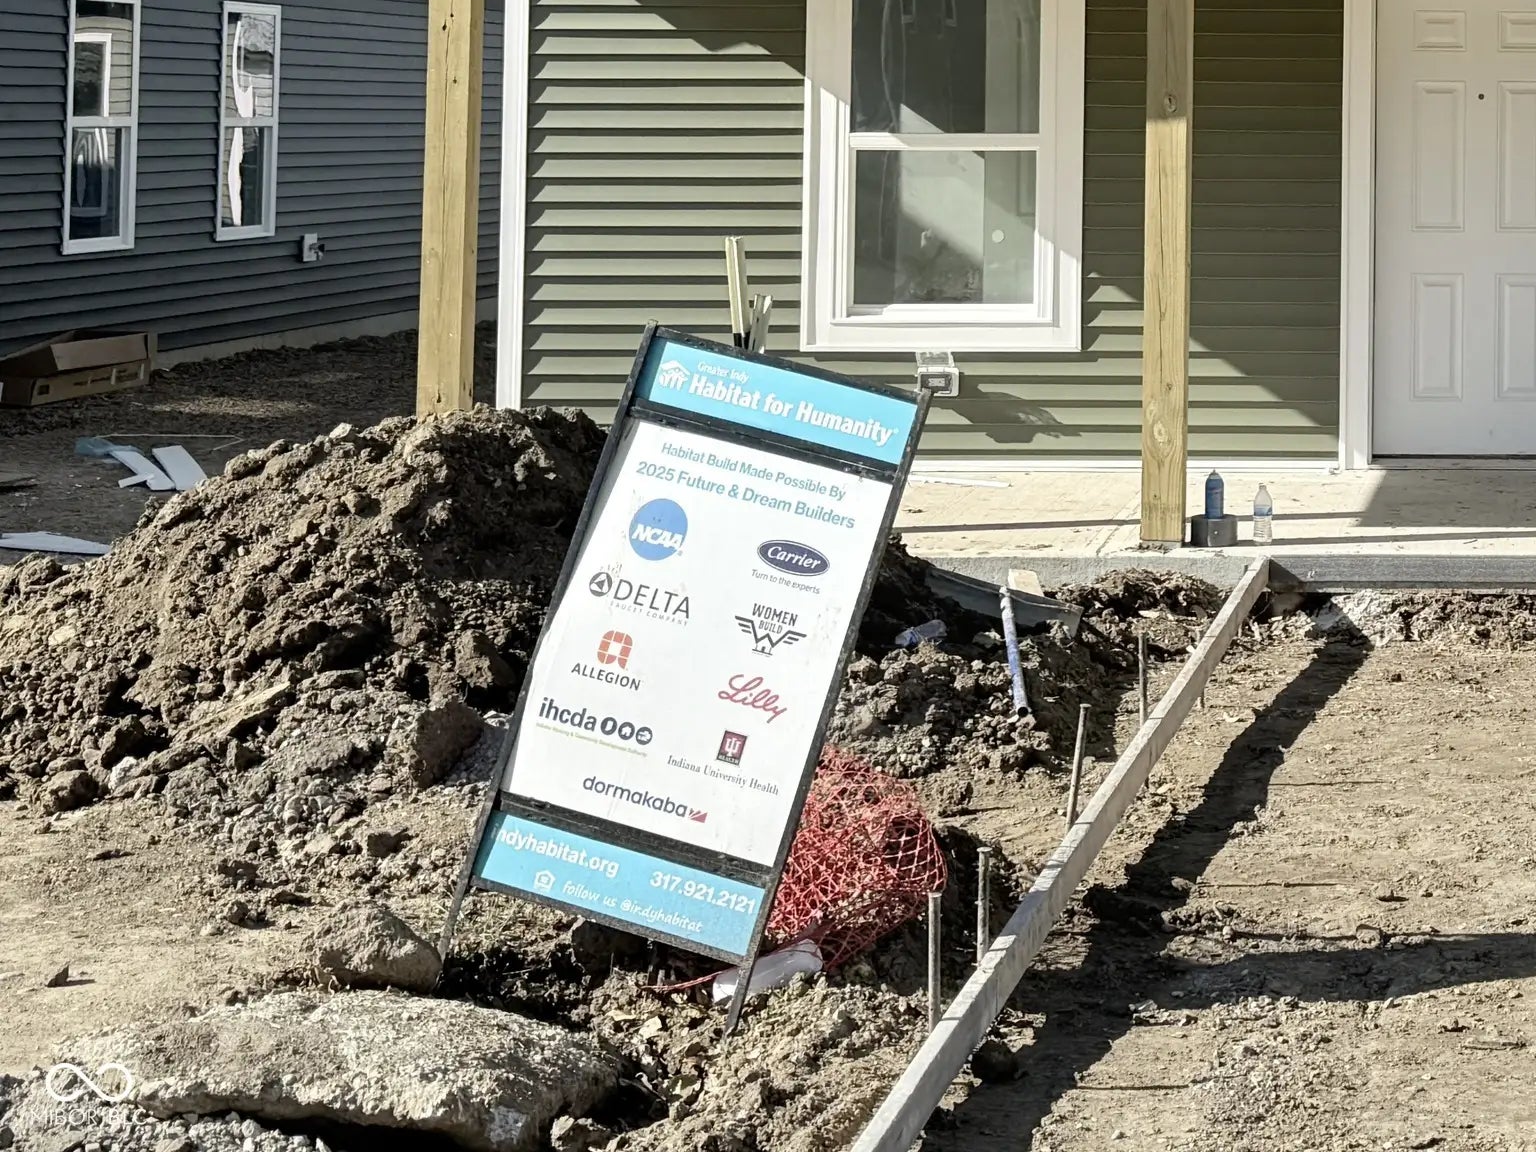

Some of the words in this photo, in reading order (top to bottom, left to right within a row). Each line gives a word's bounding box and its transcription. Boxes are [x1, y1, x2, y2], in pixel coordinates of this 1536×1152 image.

[697, 361, 729, 380] Greater
[730, 369, 750, 385] Indy
[688, 374, 760, 414] Habitat
[762, 392, 793, 418] for
[795, 401, 894, 448] Humanity
[661, 442, 706, 464] Habitat
[705, 454, 738, 473] Build
[738, 461, 773, 482] Made
[775, 471, 827, 495] Possible
[828, 484, 847, 502] By
[636, 460, 675, 483] 2025
[676, 470, 726, 496] Future
[727, 484, 745, 499] &
[742, 486, 792, 515] Dream
[794, 499, 856, 530] Builders
[631, 523, 684, 550] NCAA
[767, 546, 821, 569] Carrier
[751, 569, 768, 581] Turn
[769, 574, 778, 583] to
[778, 576, 791, 587] the
[791, 581, 820, 595] experts
[609, 600, 643, 617] FAUCET
[646, 611, 688, 627] COMPANY
[613, 579, 690, 619] DELTA
[752, 603, 798, 627] WOMEN
[758, 619, 783, 634] BUILD
[571, 662, 641, 691] ALLEGION
[538, 696, 597, 732] ihcda
[718, 674, 787, 724] Lilly
[667, 754, 701, 773] Indiana
[703, 764, 747, 789] University
[749, 777, 779, 796] Health
[582, 775, 687, 818] dormakaba
[562, 880, 601, 906] follow
[603, 894, 618, 908] us
[649, 870, 756, 915] 317.921.2121
